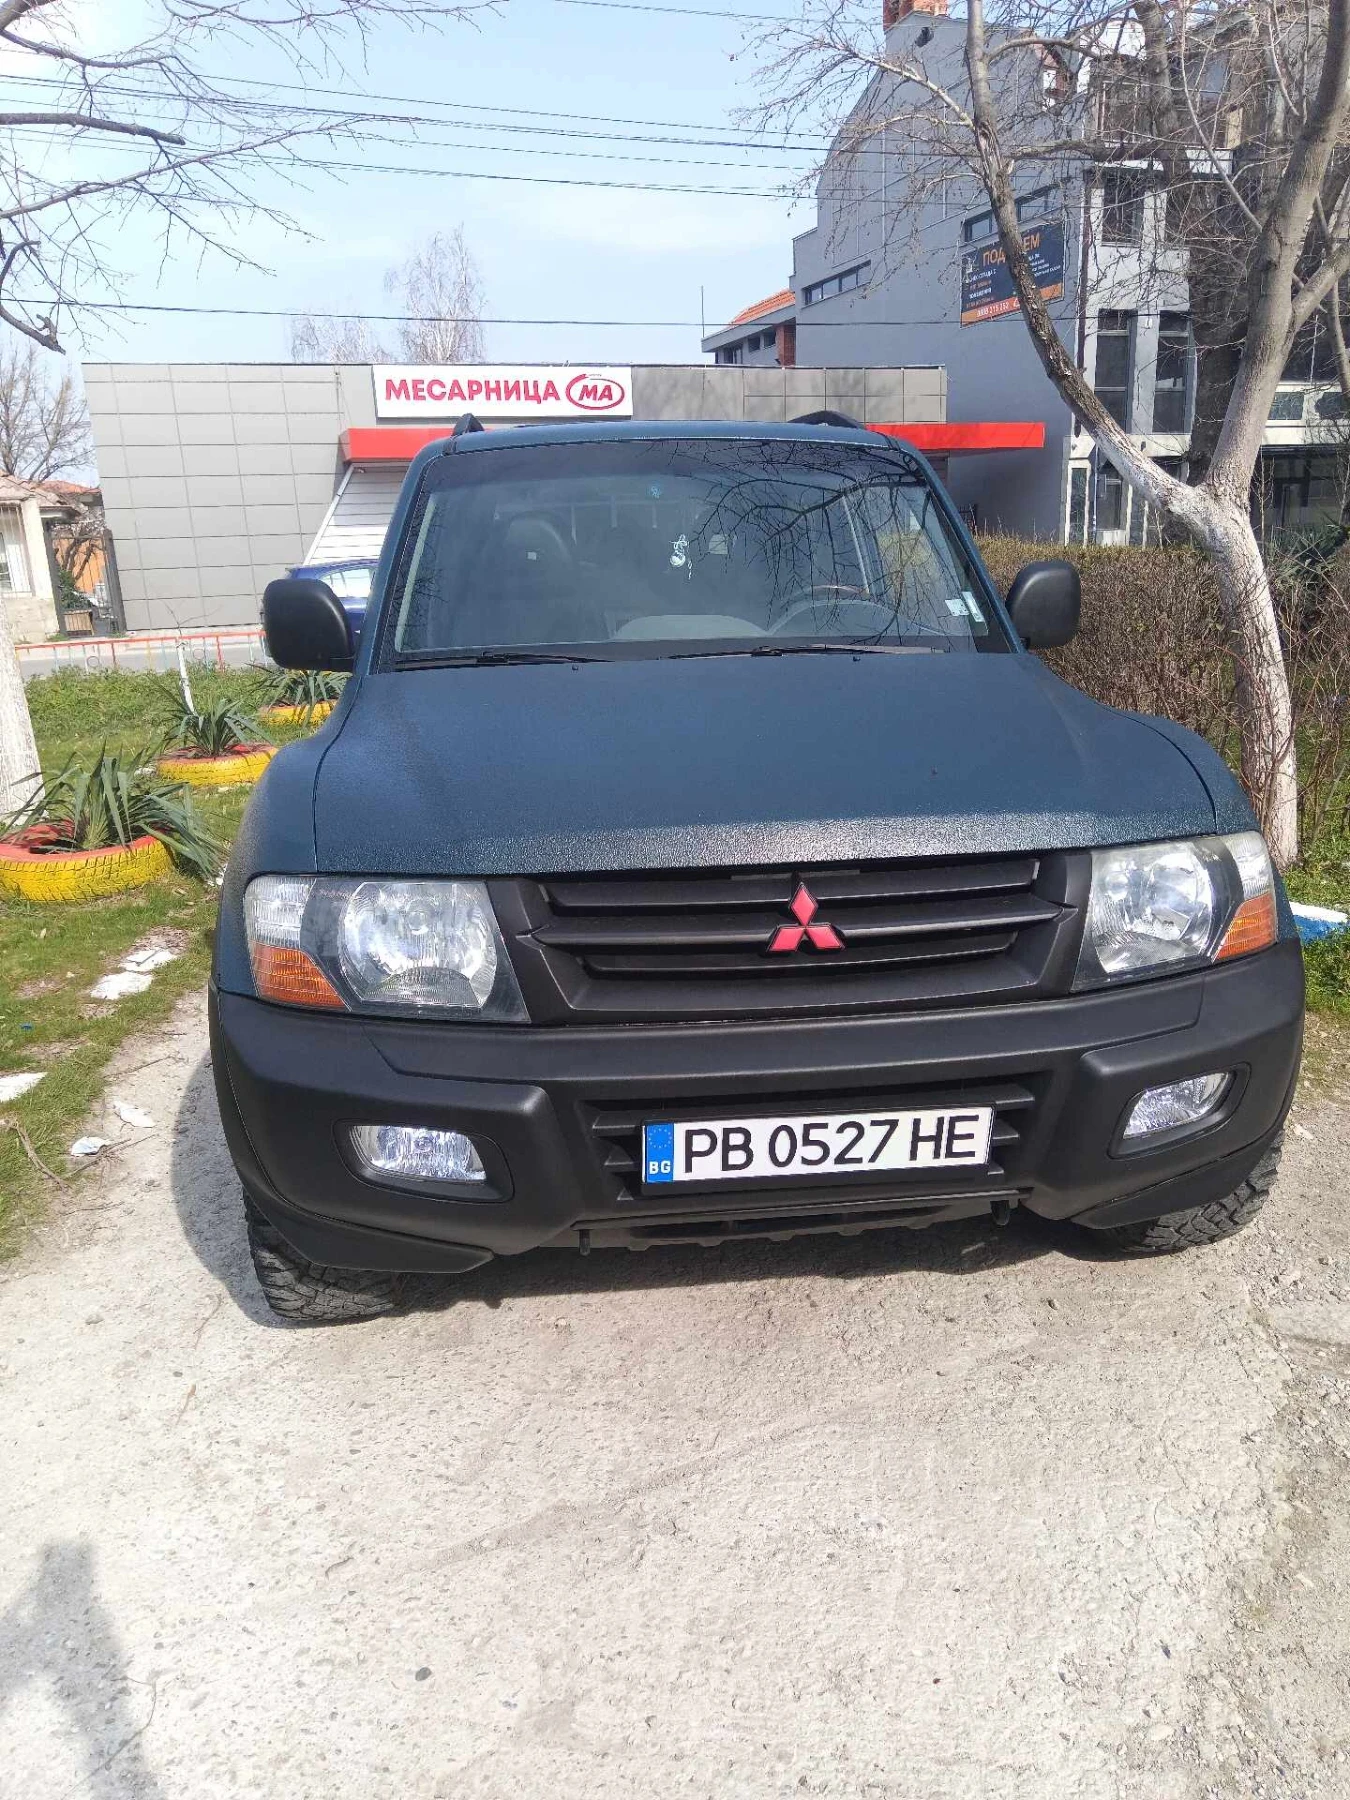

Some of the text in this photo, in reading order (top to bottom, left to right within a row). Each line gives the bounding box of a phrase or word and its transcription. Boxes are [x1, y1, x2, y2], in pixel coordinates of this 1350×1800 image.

[983, 247, 1006, 266] ПОД
[385, 379, 613, 404] МЕСАРНИЦА МА
[684, 1114, 979, 1174] PB 0527 HE
[649, 1161, 671, 1175] BG
